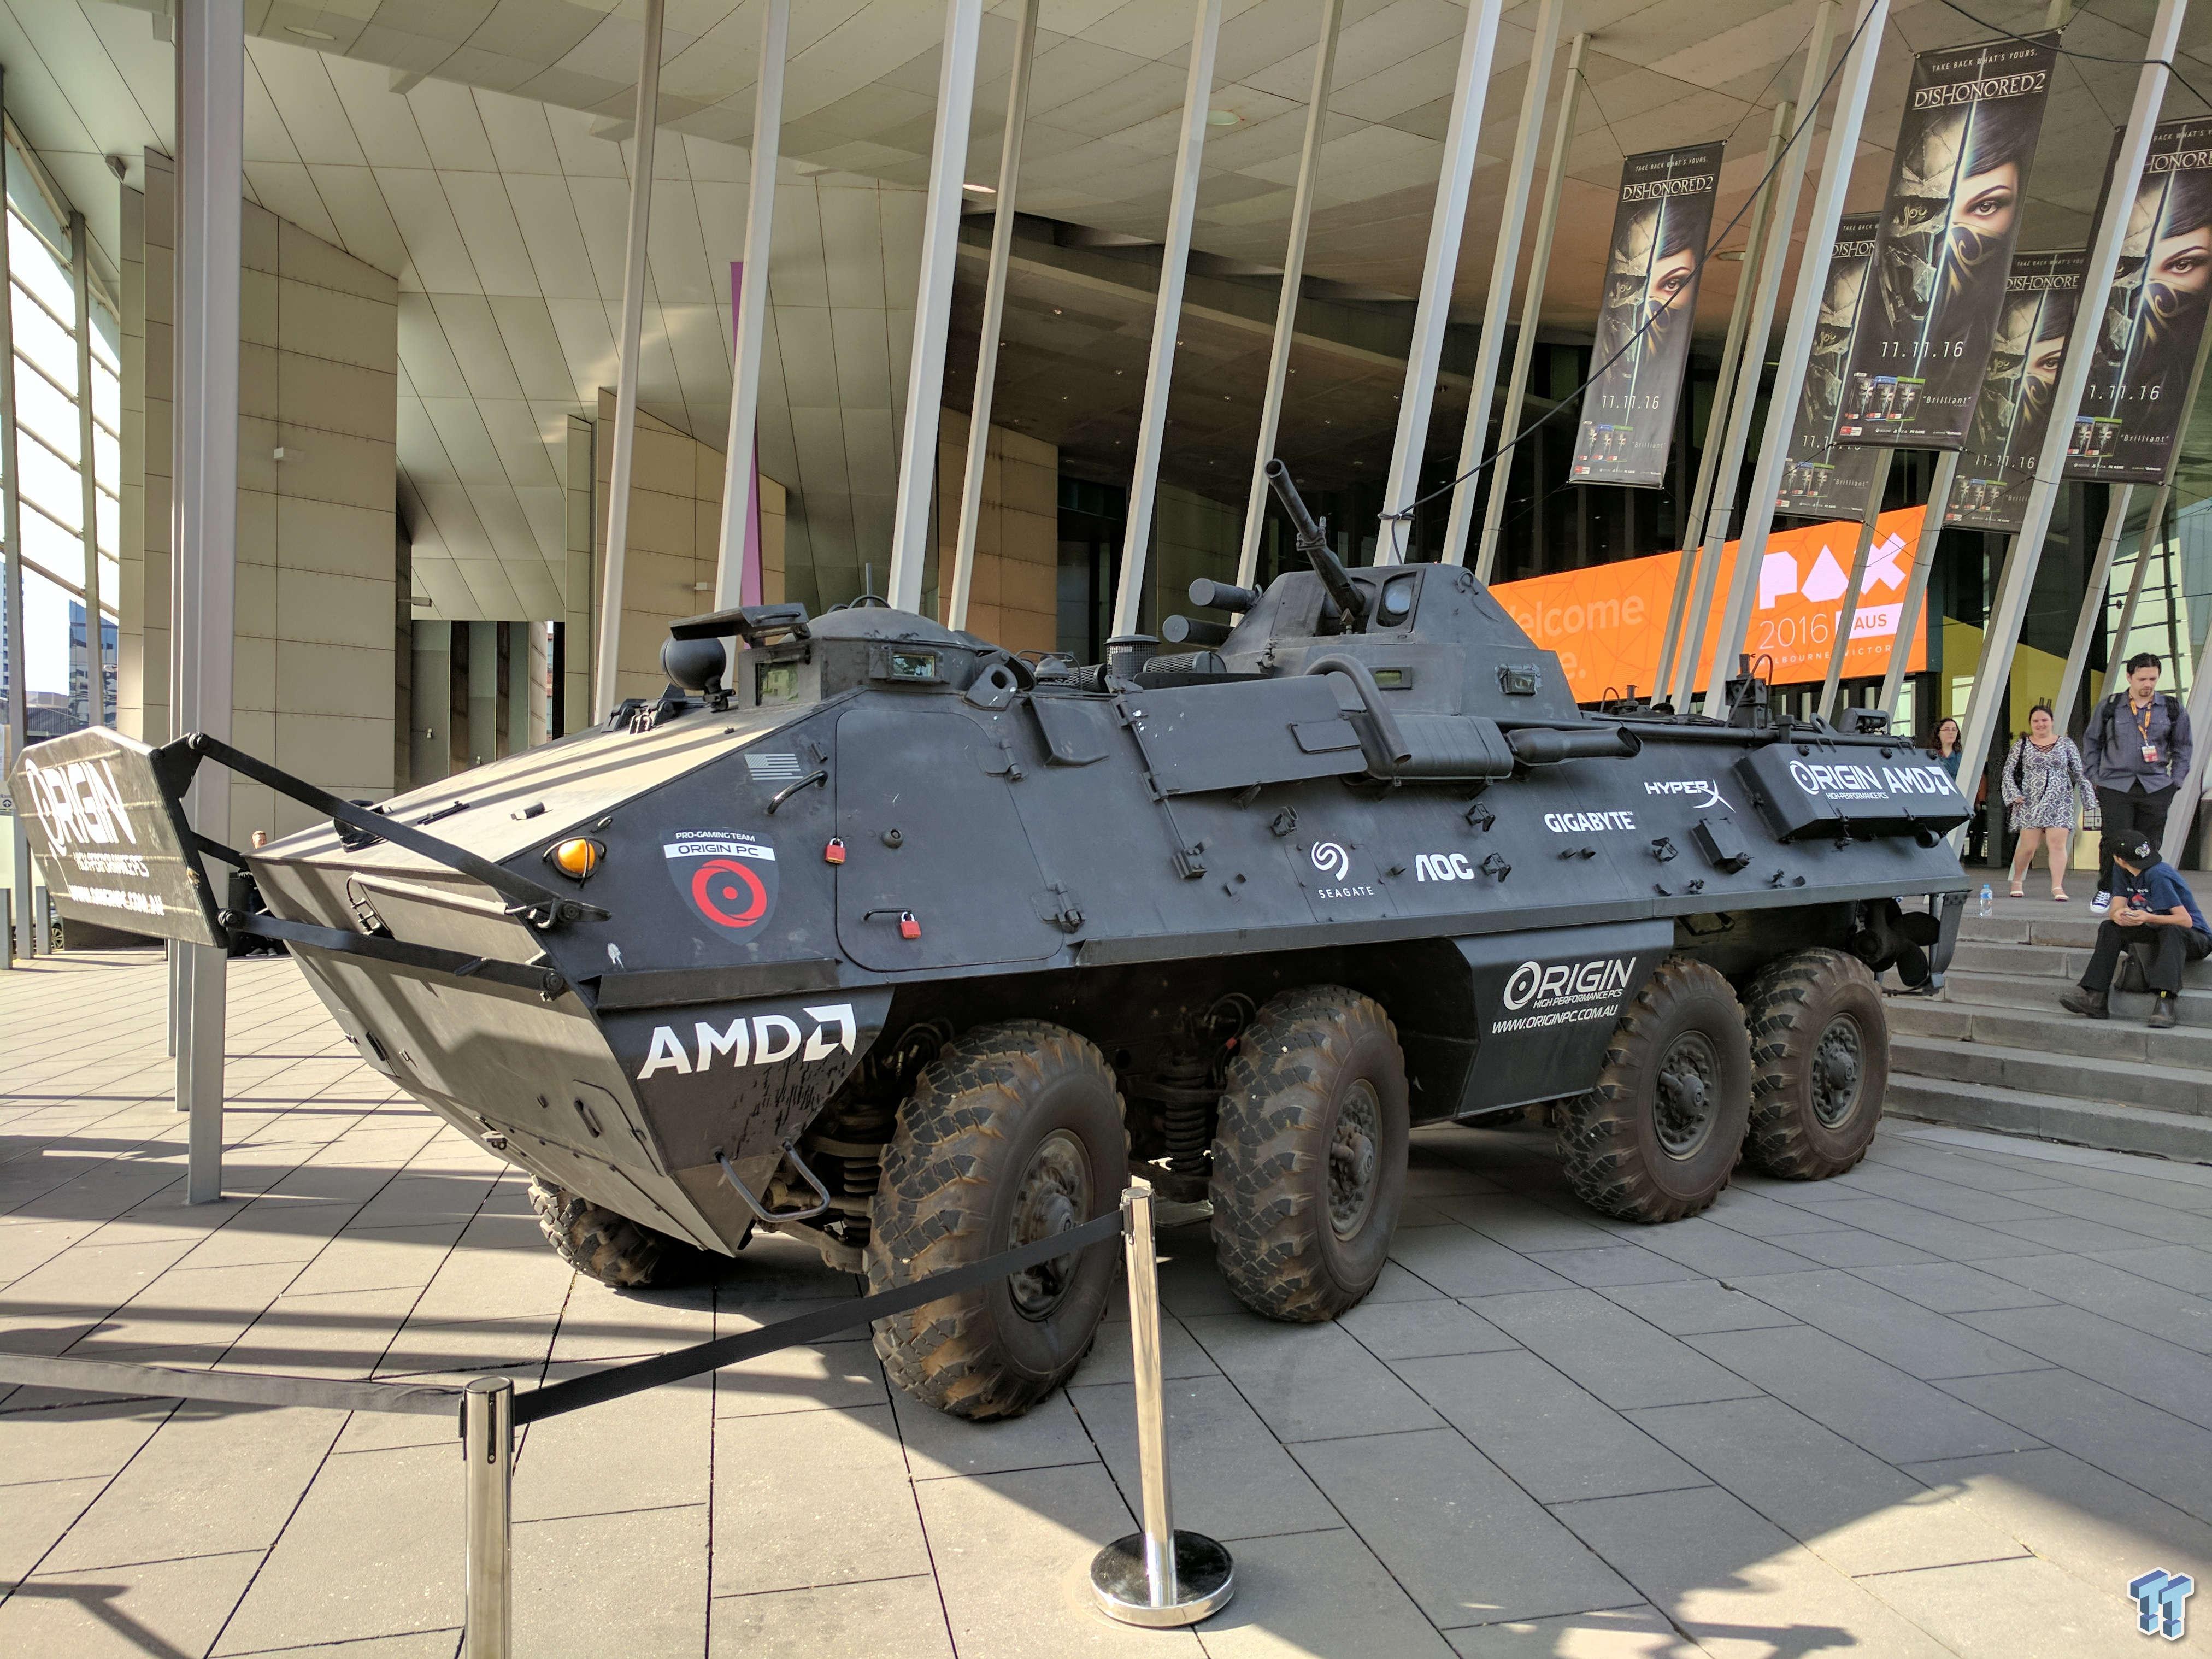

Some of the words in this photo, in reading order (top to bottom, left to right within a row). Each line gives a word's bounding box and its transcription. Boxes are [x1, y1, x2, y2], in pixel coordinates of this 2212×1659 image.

[1932, 63, 1950, 72] TAKE
[1953, 58, 1973, 68] BACK
[1976, 53, 2005, 65] WHAT'S
[2154, 133, 2173, 142] BACK
[1881, 341, 1964, 358] 11.11.16
[1602, 395, 1660, 409] 11.11.16
[1975, 454, 2035, 469] 11.11.16
[1759, 532, 1907, 610] PAX
[1758, 613, 1828, 650] 2016
[1854, 614, 1887, 630] AUS
[1789, 760, 1883, 795] ORIGIN
[1882, 766, 1936, 794] AMD
[25, 758, 137, 857] ORIGIN
[675, 831, 731, 839] PRO-GAMING
[730, 832, 756, 842] TEAM
[678, 844, 731, 854] ORIGIN
[736, 846, 759, 856] PC
[1318, 886, 1374, 899] SEAGATE
[1503, 957, 1637, 1010] ORIGIN
[1533, 998, 1552, 1009] HIGH
[1552, 990, 1609, 1006] PERFORMANCE
[1608, 988, 1623, 998] PCS
[1492, 1004, 1619, 1034] WWW.ORIGINPC.COM.AU
[637, 1014, 802, 1080] AMD
